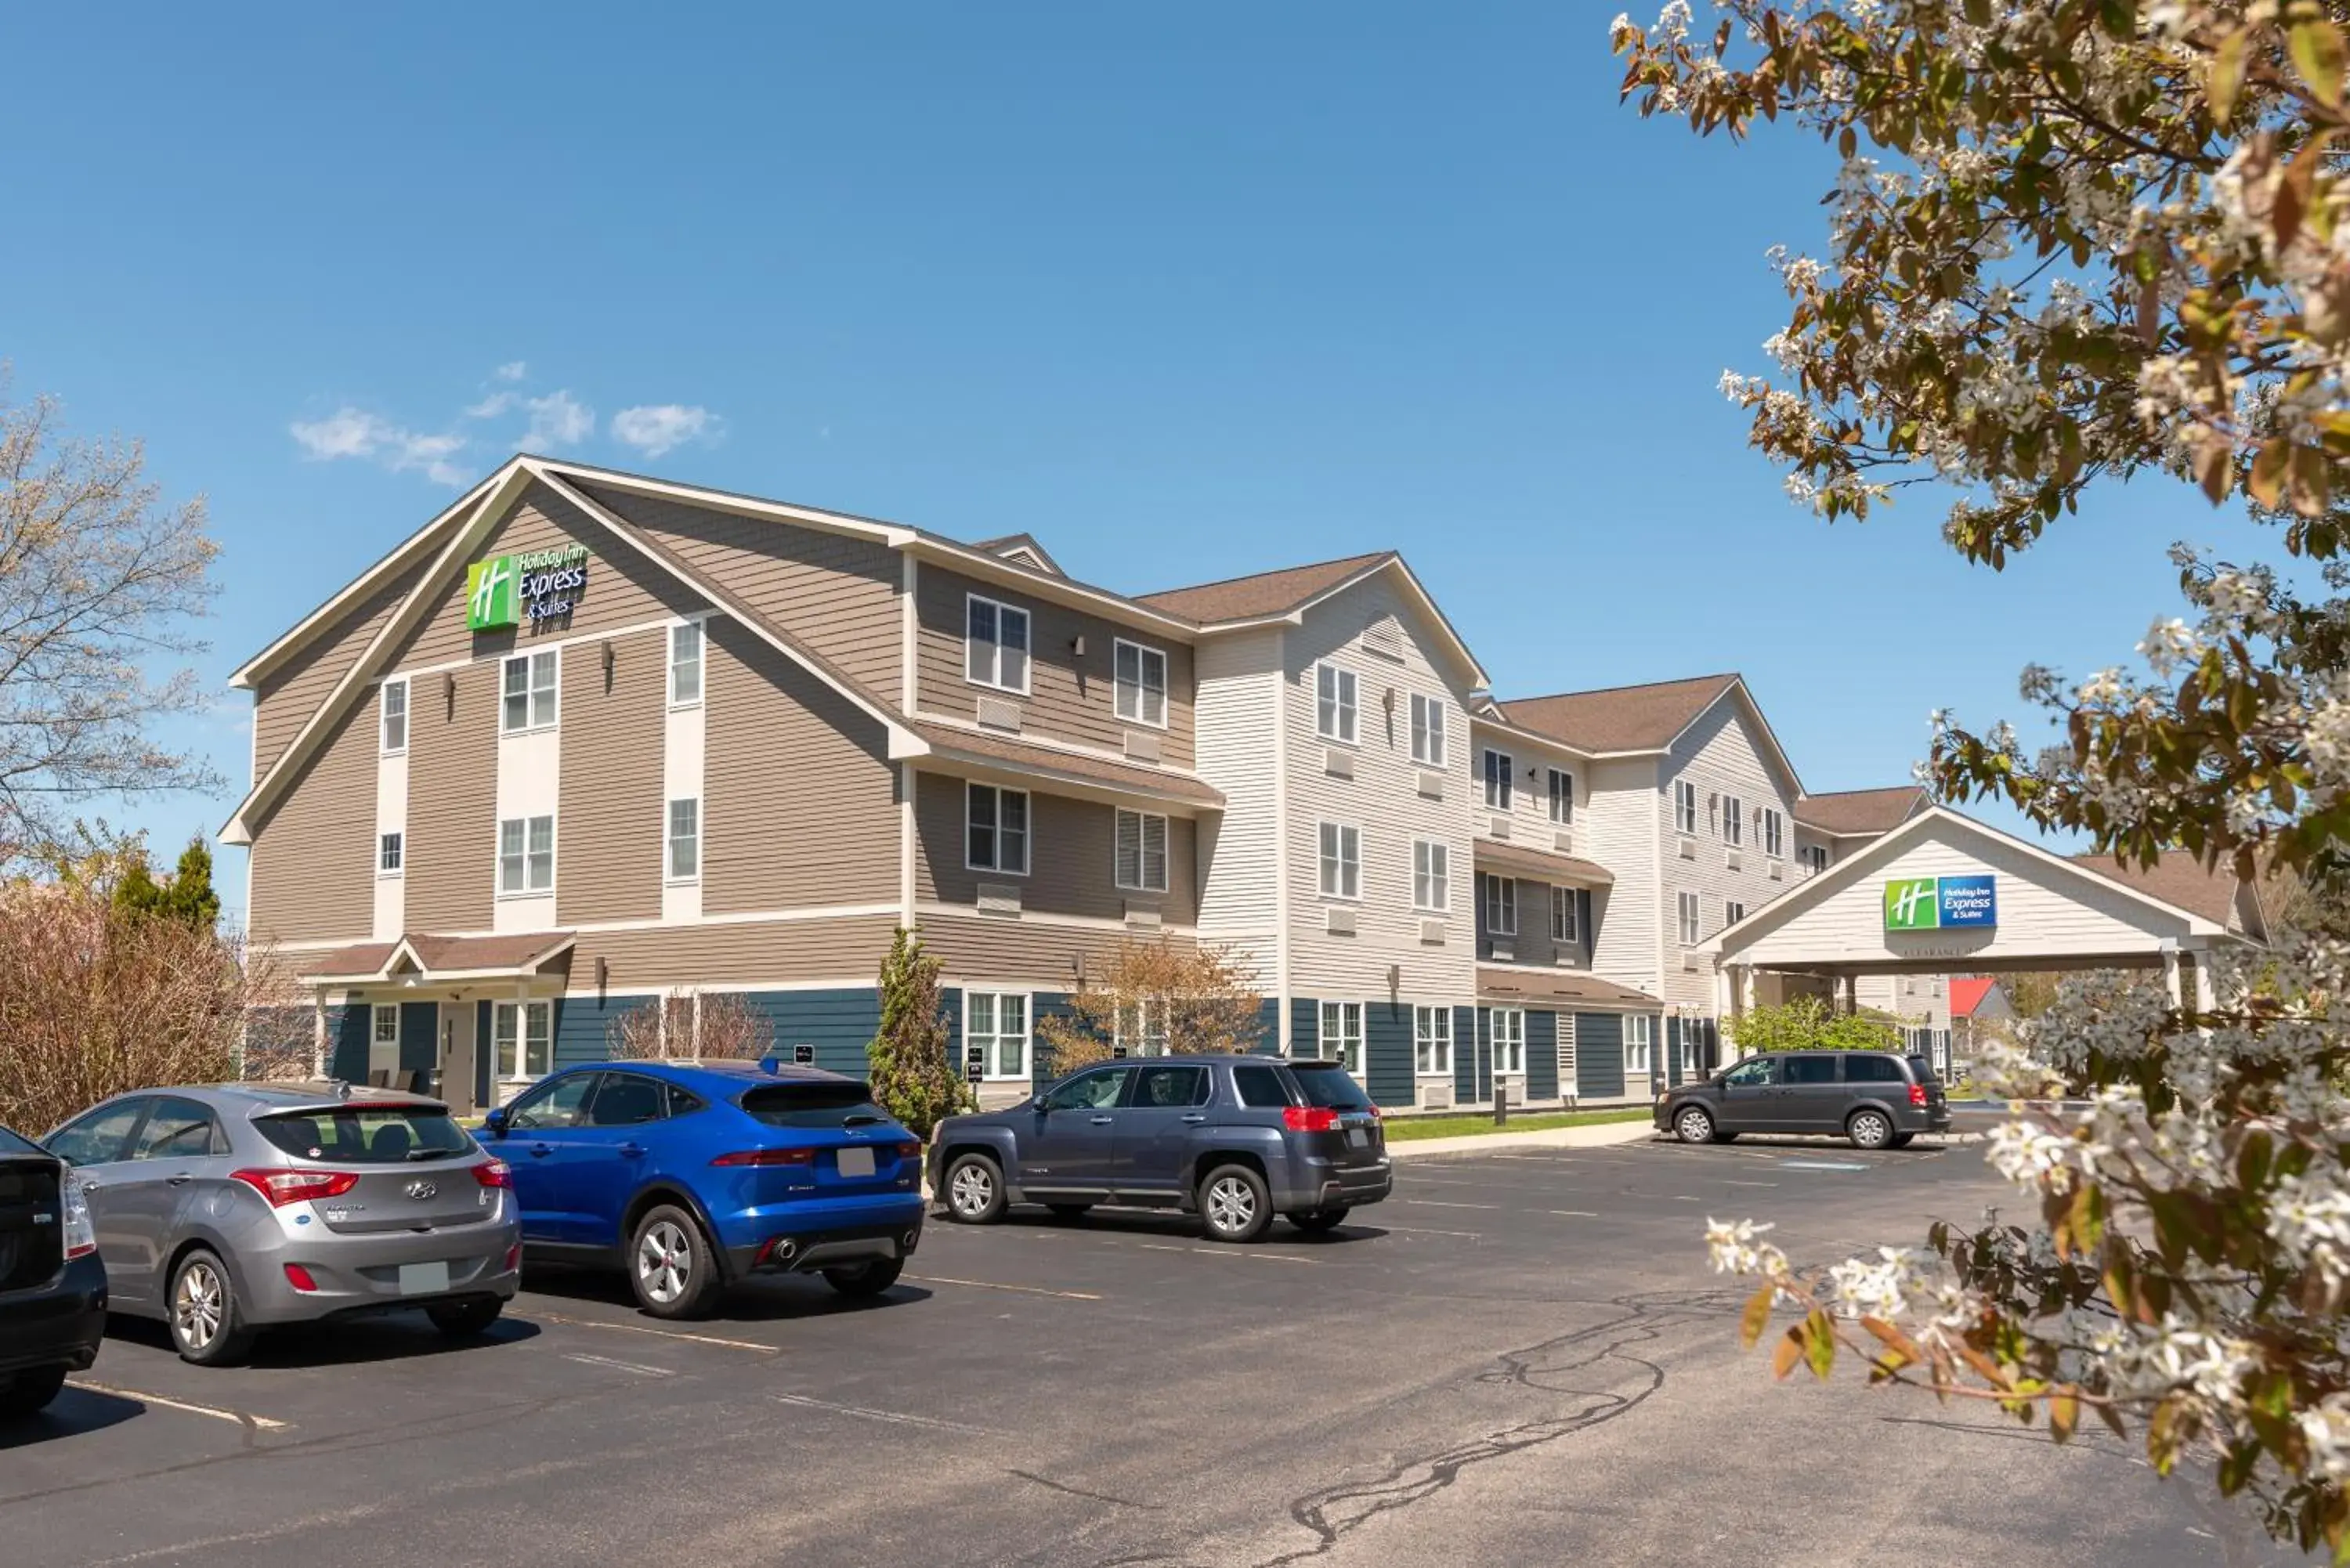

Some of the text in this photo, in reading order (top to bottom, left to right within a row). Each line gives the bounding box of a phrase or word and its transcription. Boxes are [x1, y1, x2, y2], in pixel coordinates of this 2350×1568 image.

[519, 544, 584, 571] Holiday Inn
[518, 566, 584, 601] Express
[537, 599, 569, 617] Suites
[1943, 887, 1976, 898] Holiday
[1944, 898, 1991, 911] Express
[1959, 910, 1983, 919] Suites
